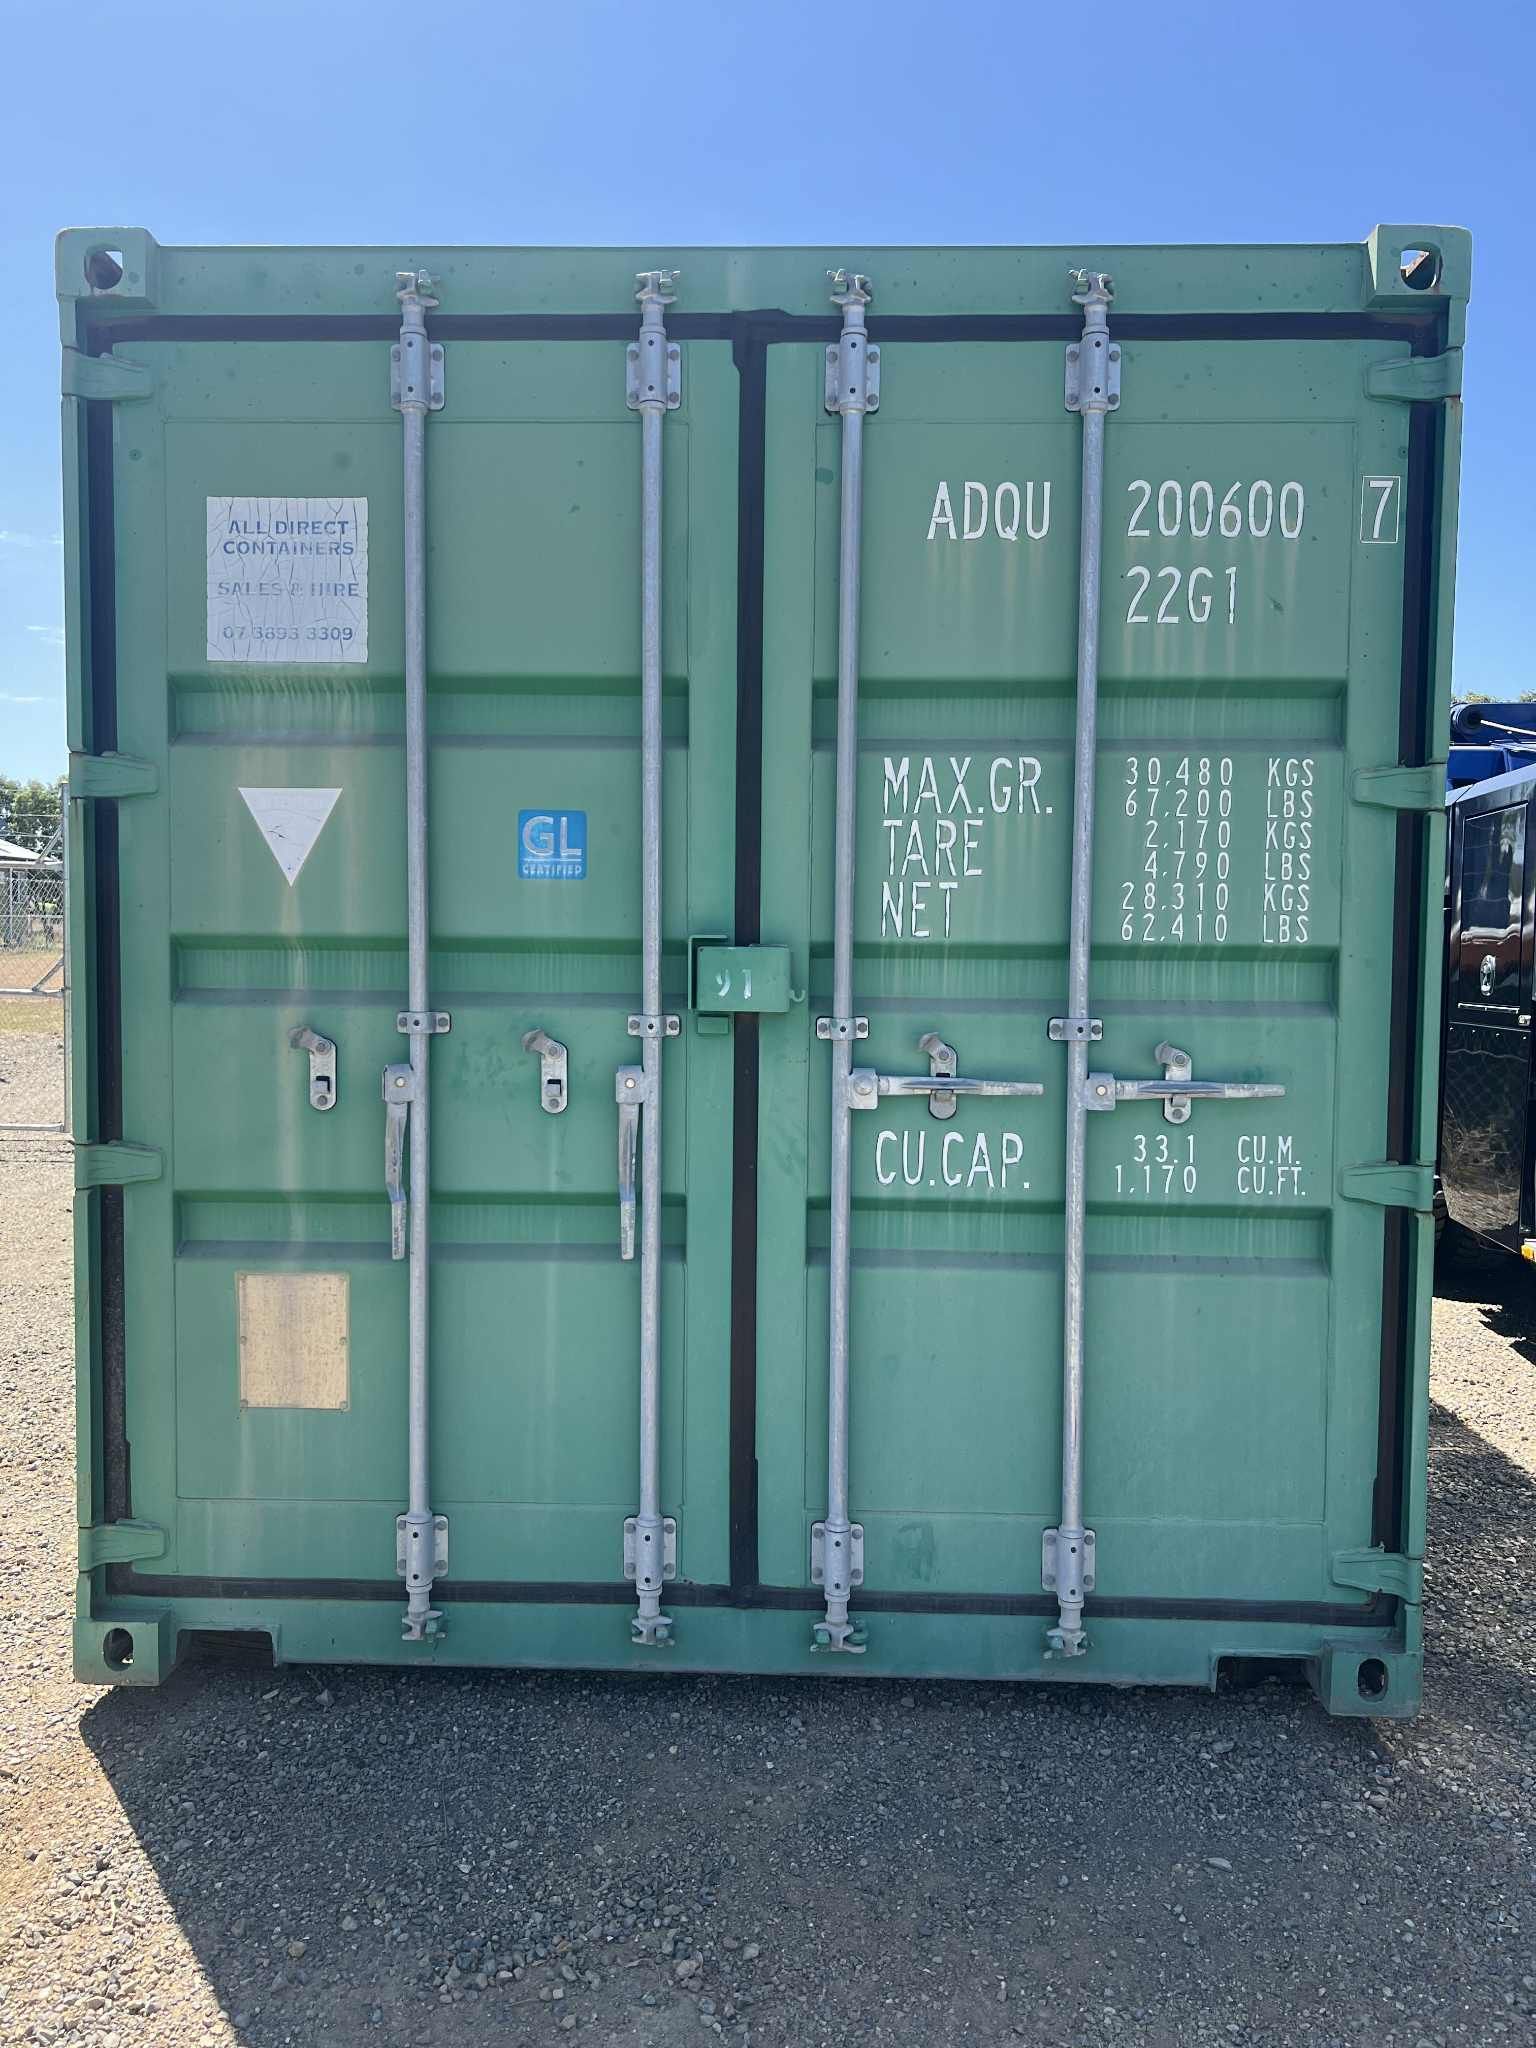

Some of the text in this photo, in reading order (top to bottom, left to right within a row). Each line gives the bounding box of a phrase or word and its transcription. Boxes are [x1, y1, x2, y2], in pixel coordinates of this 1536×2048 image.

[926, 479, 1394, 541] ADQU 200600 7
[228, 520, 349, 535] ALL DIRECT
[223, 541, 354, 556] CONTAINERS
[217, 582, 282, 596] SALES
[311, 583, 359, 597] HIRE
[1126, 566, 1238, 624] 22G1
[223, 626, 246, 640] 07
[306, 626, 353, 641] 3309
[883, 757, 1314, 814] MAX.GR. 30,480 KGS
[1125, 788, 1312, 818] 67,200 LBS
[522, 816, 582, 856] GL
[883, 820, 1312, 876] TARE 2,170 KGS
[1144, 851, 1311, 881] 4,790 LBS
[881, 881, 1311, 937] NET 28,310 KGS
[1121, 913, 1309, 943] 62,410 LBS
[875, 1130, 1301, 1188] CU.CAP. 33.1 CU.M.
[1115, 1165, 1306, 1195] 1,170 CU.FT.
